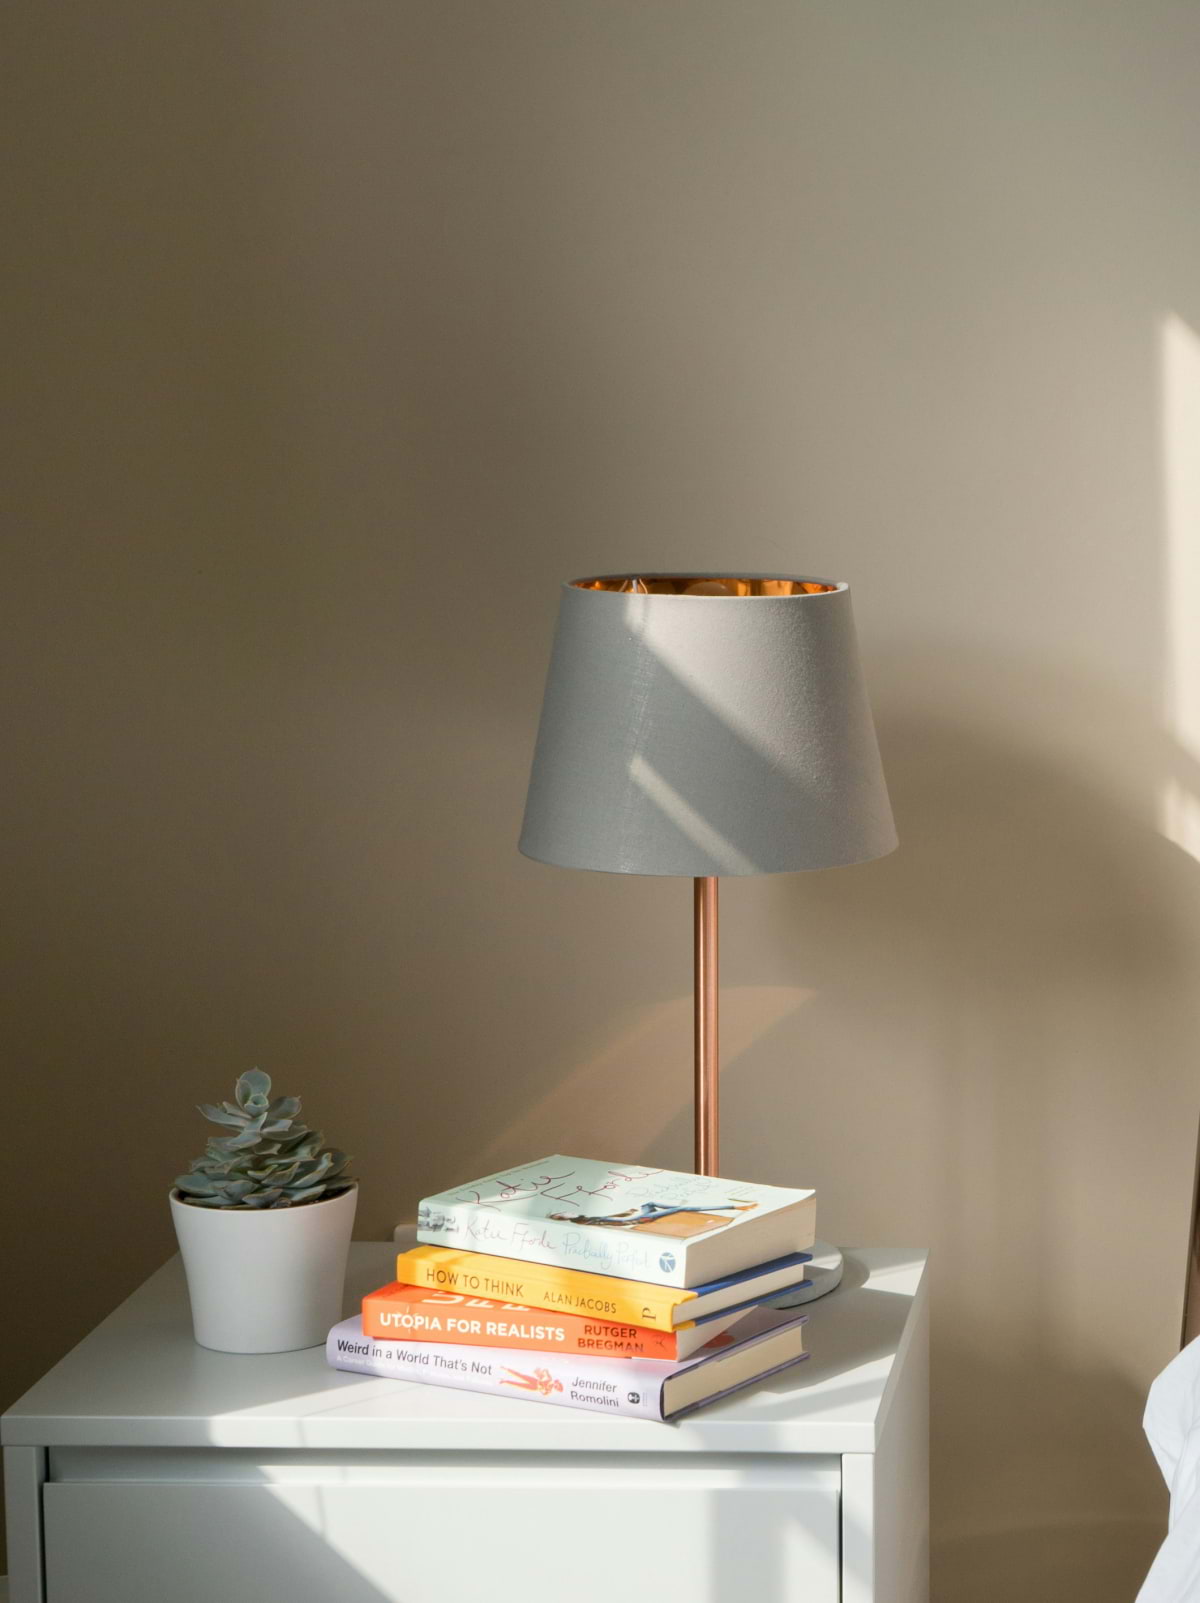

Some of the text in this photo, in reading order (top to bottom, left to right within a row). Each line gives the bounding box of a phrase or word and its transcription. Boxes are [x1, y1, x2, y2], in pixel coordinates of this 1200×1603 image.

[427, 1268, 524, 1298] HOW TO THINK
[543, 1291, 572, 1305] ALAN
[575, 1296, 617, 1314] JACOBS
[380, 1312, 565, 1342] UTOPIA FOR REALISTS
[584, 1324, 637, 1339] RUTGER
[577, 1338, 644, 1352] BREGMAN
[337, 1339, 369, 1355] Weird
[372, 1345, 382, 1358] in
[385, 1349, 392, 1359] a
[396, 1349, 429, 1365] World
[433, 1355, 468, 1372] That's
[471, 1361, 492, 1376] Not
[572, 1377, 618, 1393] Jennifer
[570, 1390, 619, 1407] Romolini
